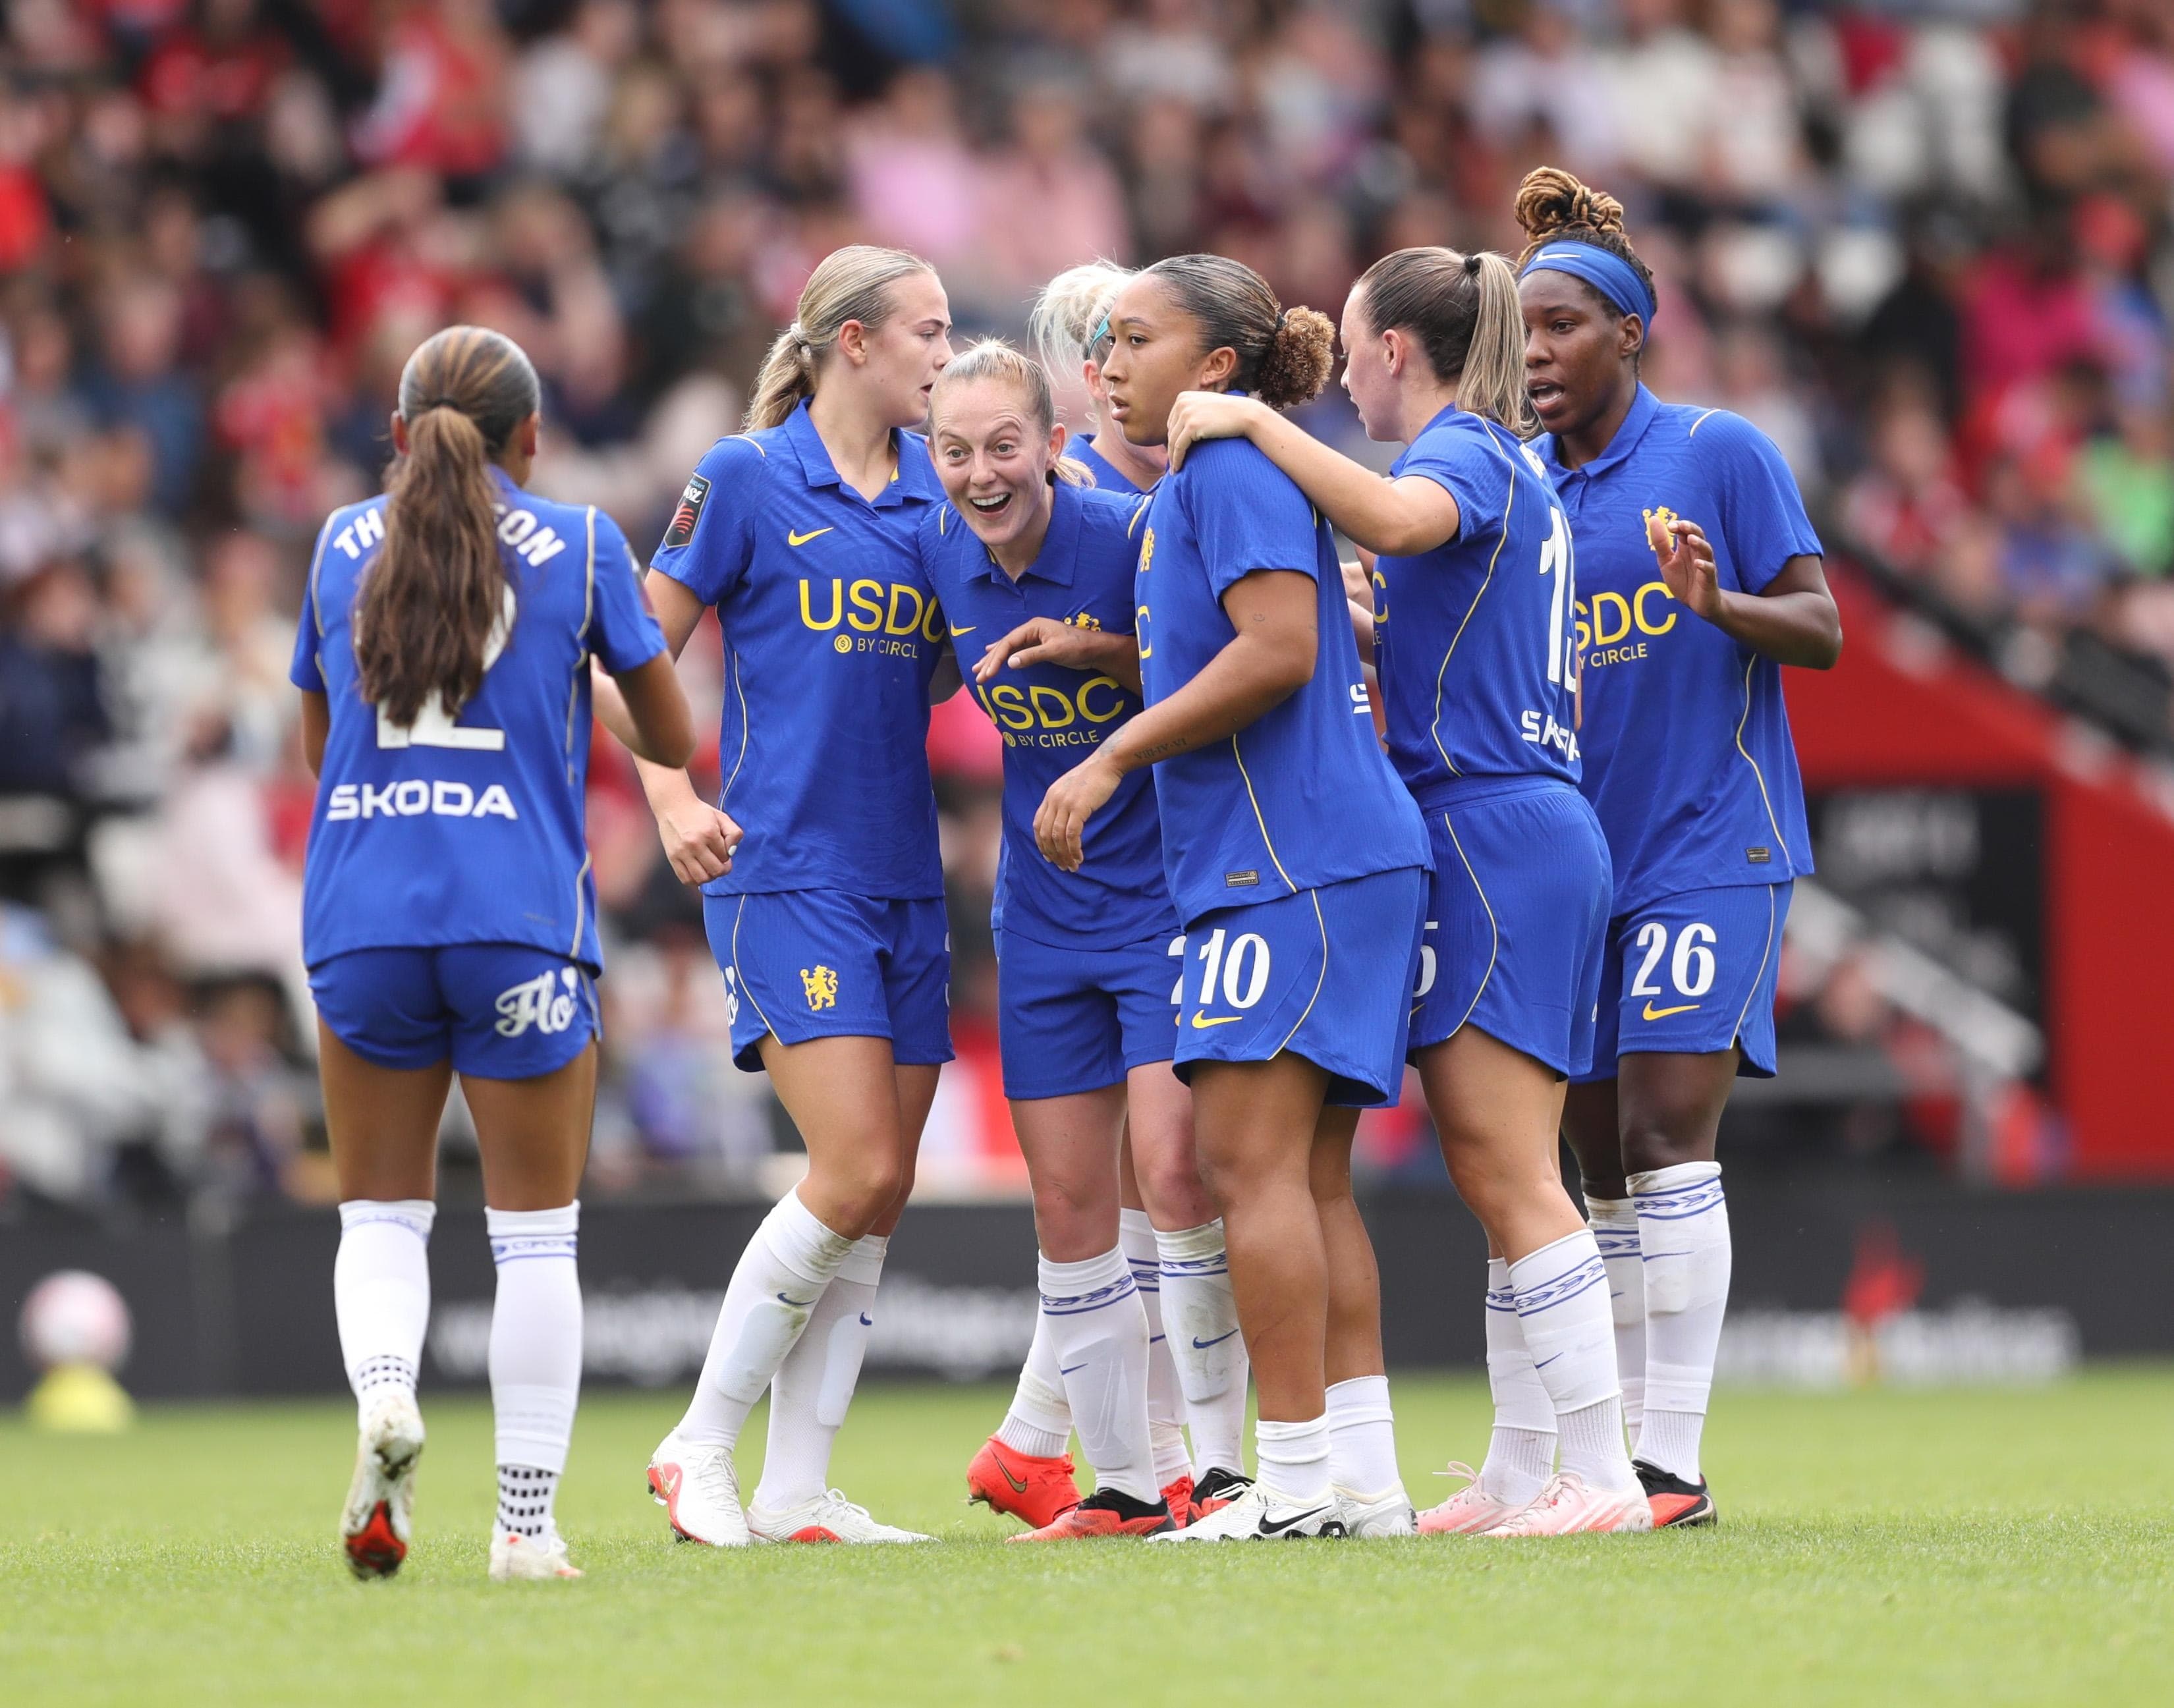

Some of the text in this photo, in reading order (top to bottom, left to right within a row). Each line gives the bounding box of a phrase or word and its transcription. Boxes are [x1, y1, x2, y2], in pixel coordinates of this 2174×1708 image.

[333, 507, 566, 567] THON
[858, 638, 918, 659] BY CIRCL
[1590, 643, 1648, 667] CIRCLE
[1018, 729, 1100, 748] BY CIRCLE
[326, 779, 518, 821] SKODA
[1198, 929, 1270, 1009] 10
[1630, 922, 1717, 997] 26
